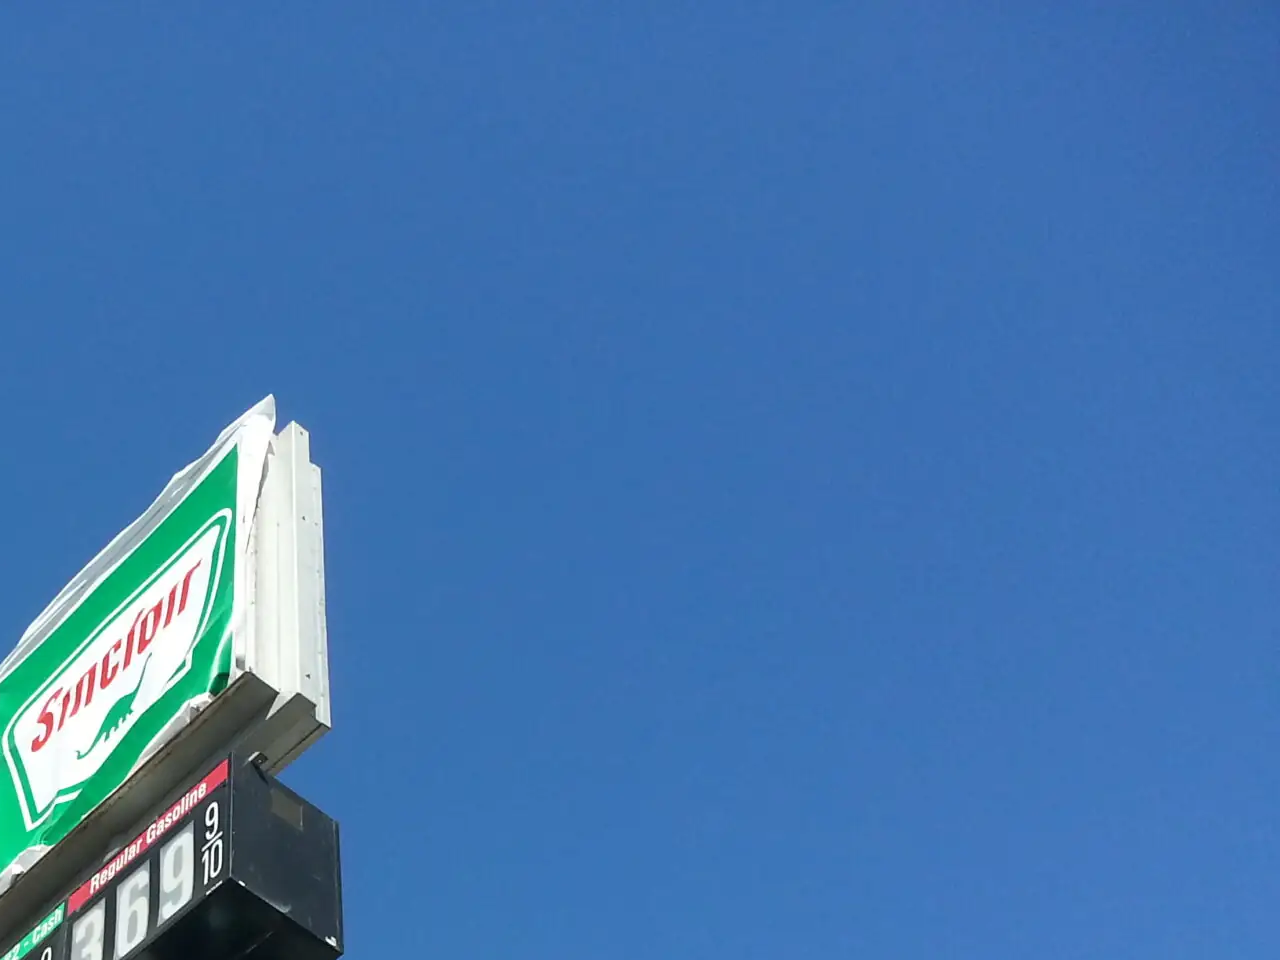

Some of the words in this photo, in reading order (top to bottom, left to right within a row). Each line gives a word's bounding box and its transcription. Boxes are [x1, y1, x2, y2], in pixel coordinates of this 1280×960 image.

[89, 838, 141, 893] Regular
[146, 783, 206, 843] Gasoline
[32, 908, 62, 945] Cash
